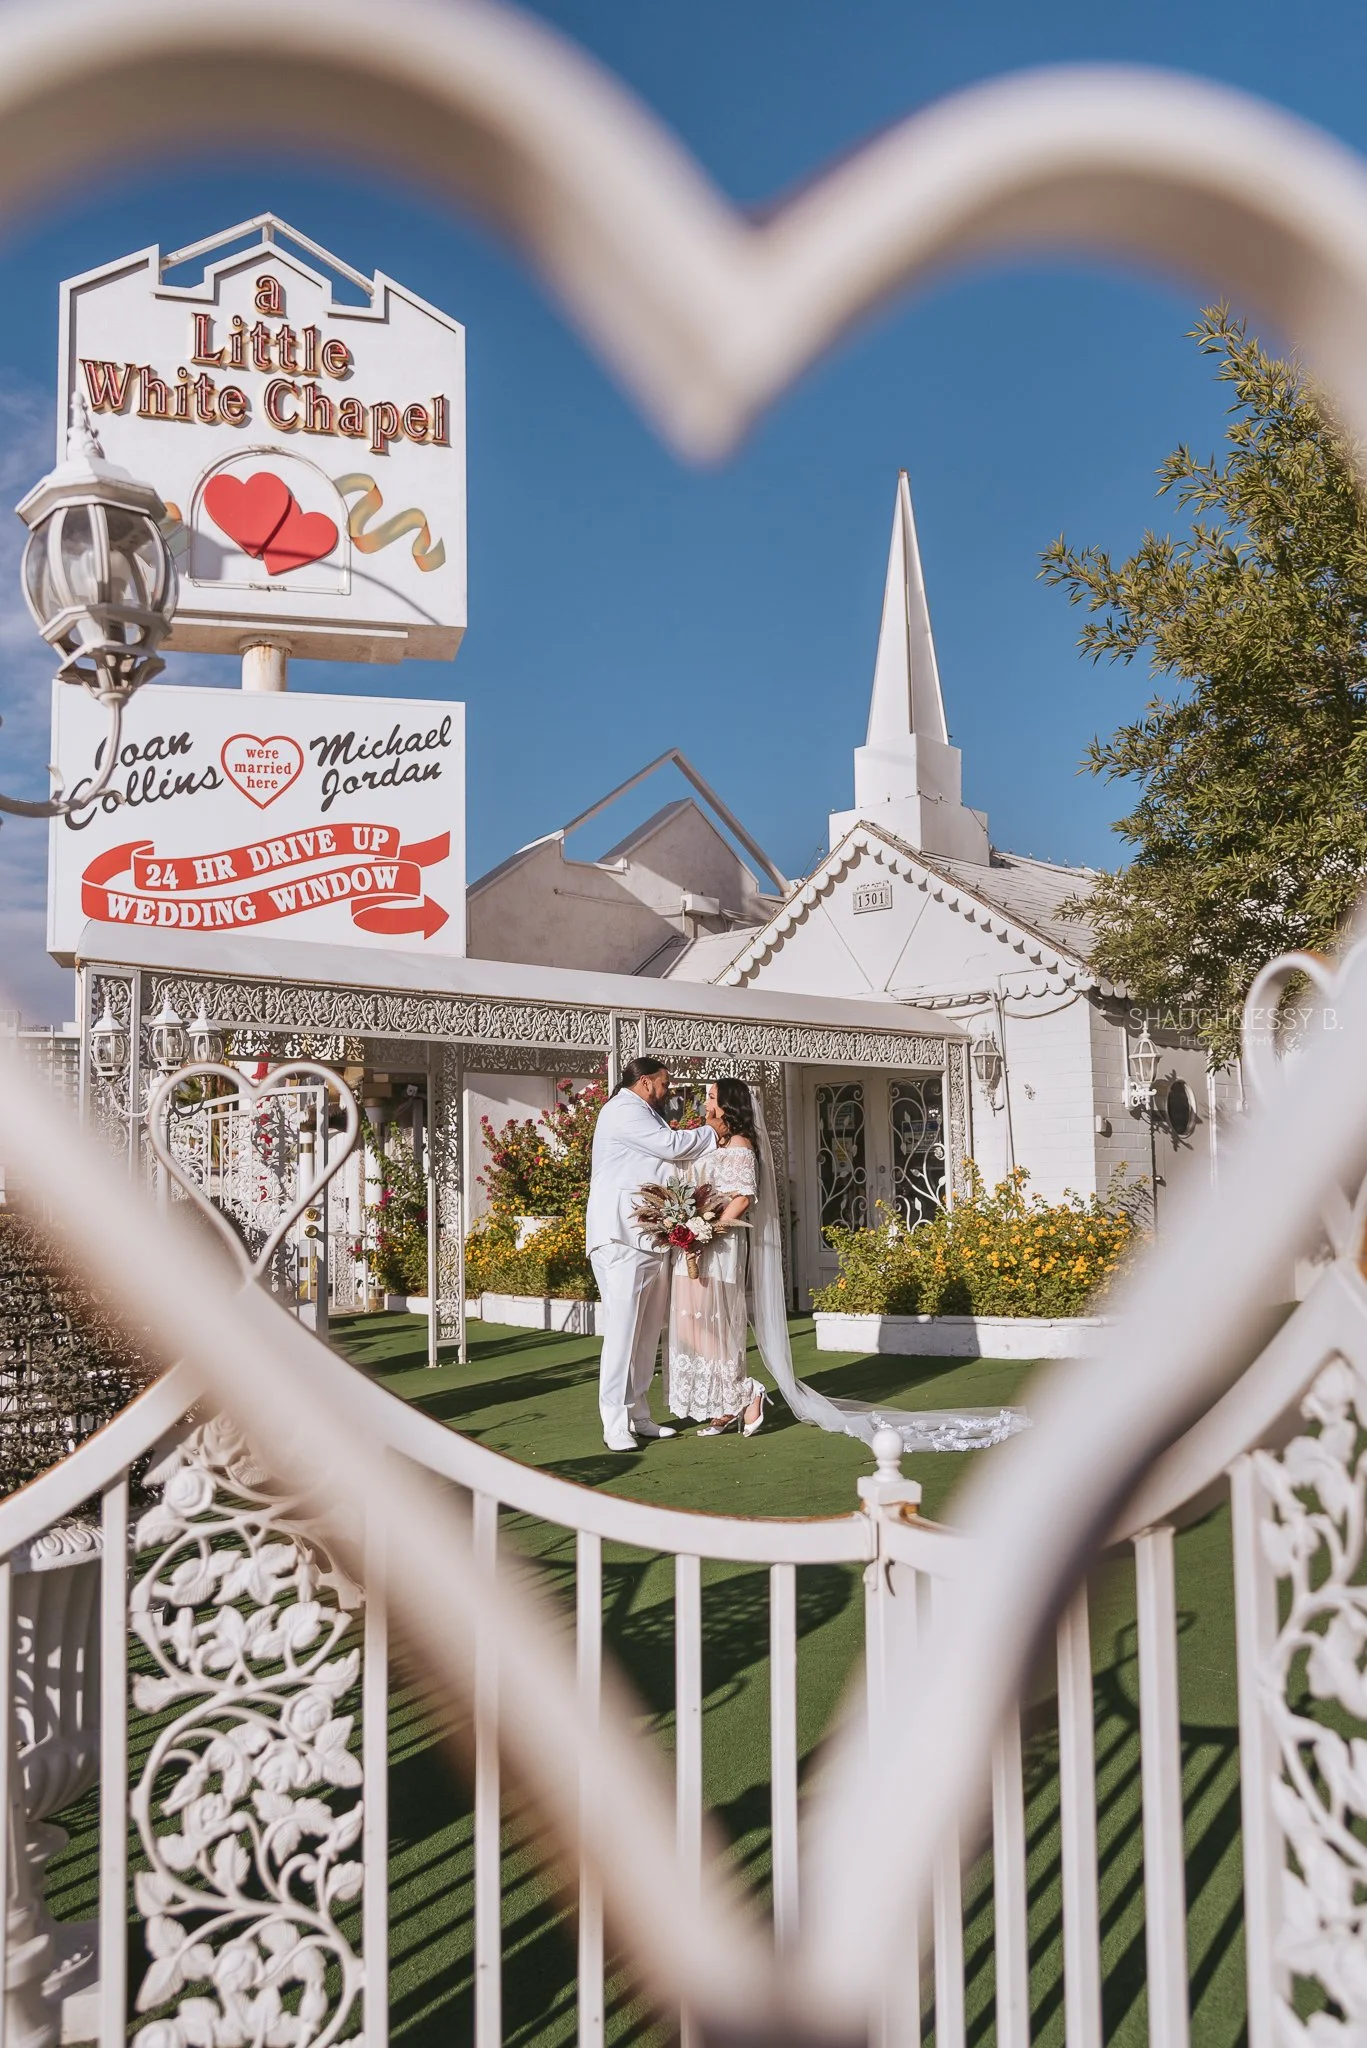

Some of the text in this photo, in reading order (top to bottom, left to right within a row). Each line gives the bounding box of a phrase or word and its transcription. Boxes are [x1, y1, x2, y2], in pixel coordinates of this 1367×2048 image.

[254, 274, 284, 316] a
[190, 312, 352, 378] Little
[79, 358, 451, 454] White Chapel
[246, 748, 279, 759] were
[309, 714, 452, 767] Michael
[234, 761, 292, 775] married
[246, 775, 278, 789] here
[320, 757, 442, 813] Jordan
[64, 765, 224, 831] Collins
[145, 826, 390, 889] 24 HR DRIVE UP
[106, 866, 400, 927] WEDDING WINDOW
[858, 891, 884, 908] 1301
